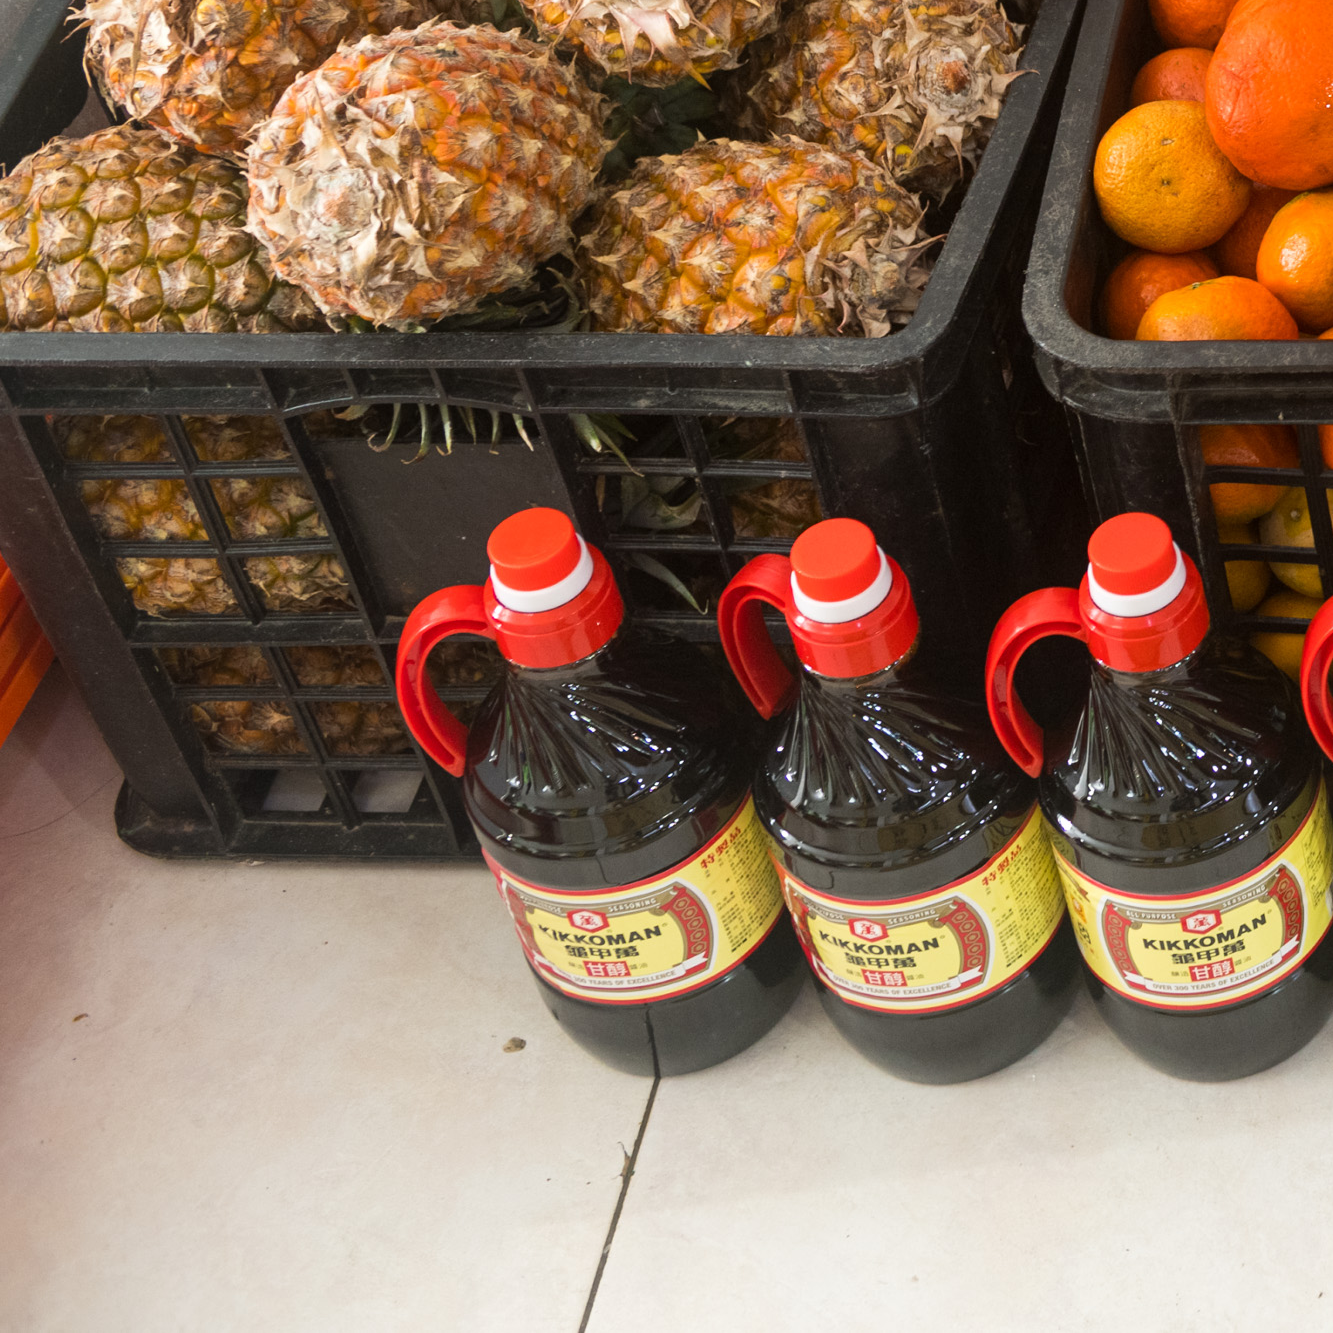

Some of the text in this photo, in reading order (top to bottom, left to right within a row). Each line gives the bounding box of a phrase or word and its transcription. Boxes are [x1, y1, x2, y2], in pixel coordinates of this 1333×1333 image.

[1222, 884, 1266, 908] SEASONING
[608, 898, 657, 913] SEASONING
[887, 908, 936, 925] SEASONING
[1142, 913, 1267, 951] KIKKOMAN
[818, 929, 940, 956] KIKKOMAN
[586, 962, 629, 977] 甘醇
[615, 978, 625, 986] OF
[626, 970, 676, 985] EXCELLENCE
[1152, 983, 1173, 991] OVER
[1174, 983, 1189, 991] 300
[1190, 980, 1217, 990] YEARS
[1229, 958, 1276, 984] EXCELLENCE
[1191, 960, 1234, 981] 甘醇
[864, 971, 905, 986] 甘醇
[865, 986, 890, 995] YEARS
[891, 987, 901, 995] OF
[903, 982, 952, 995] EXCELLENCE
